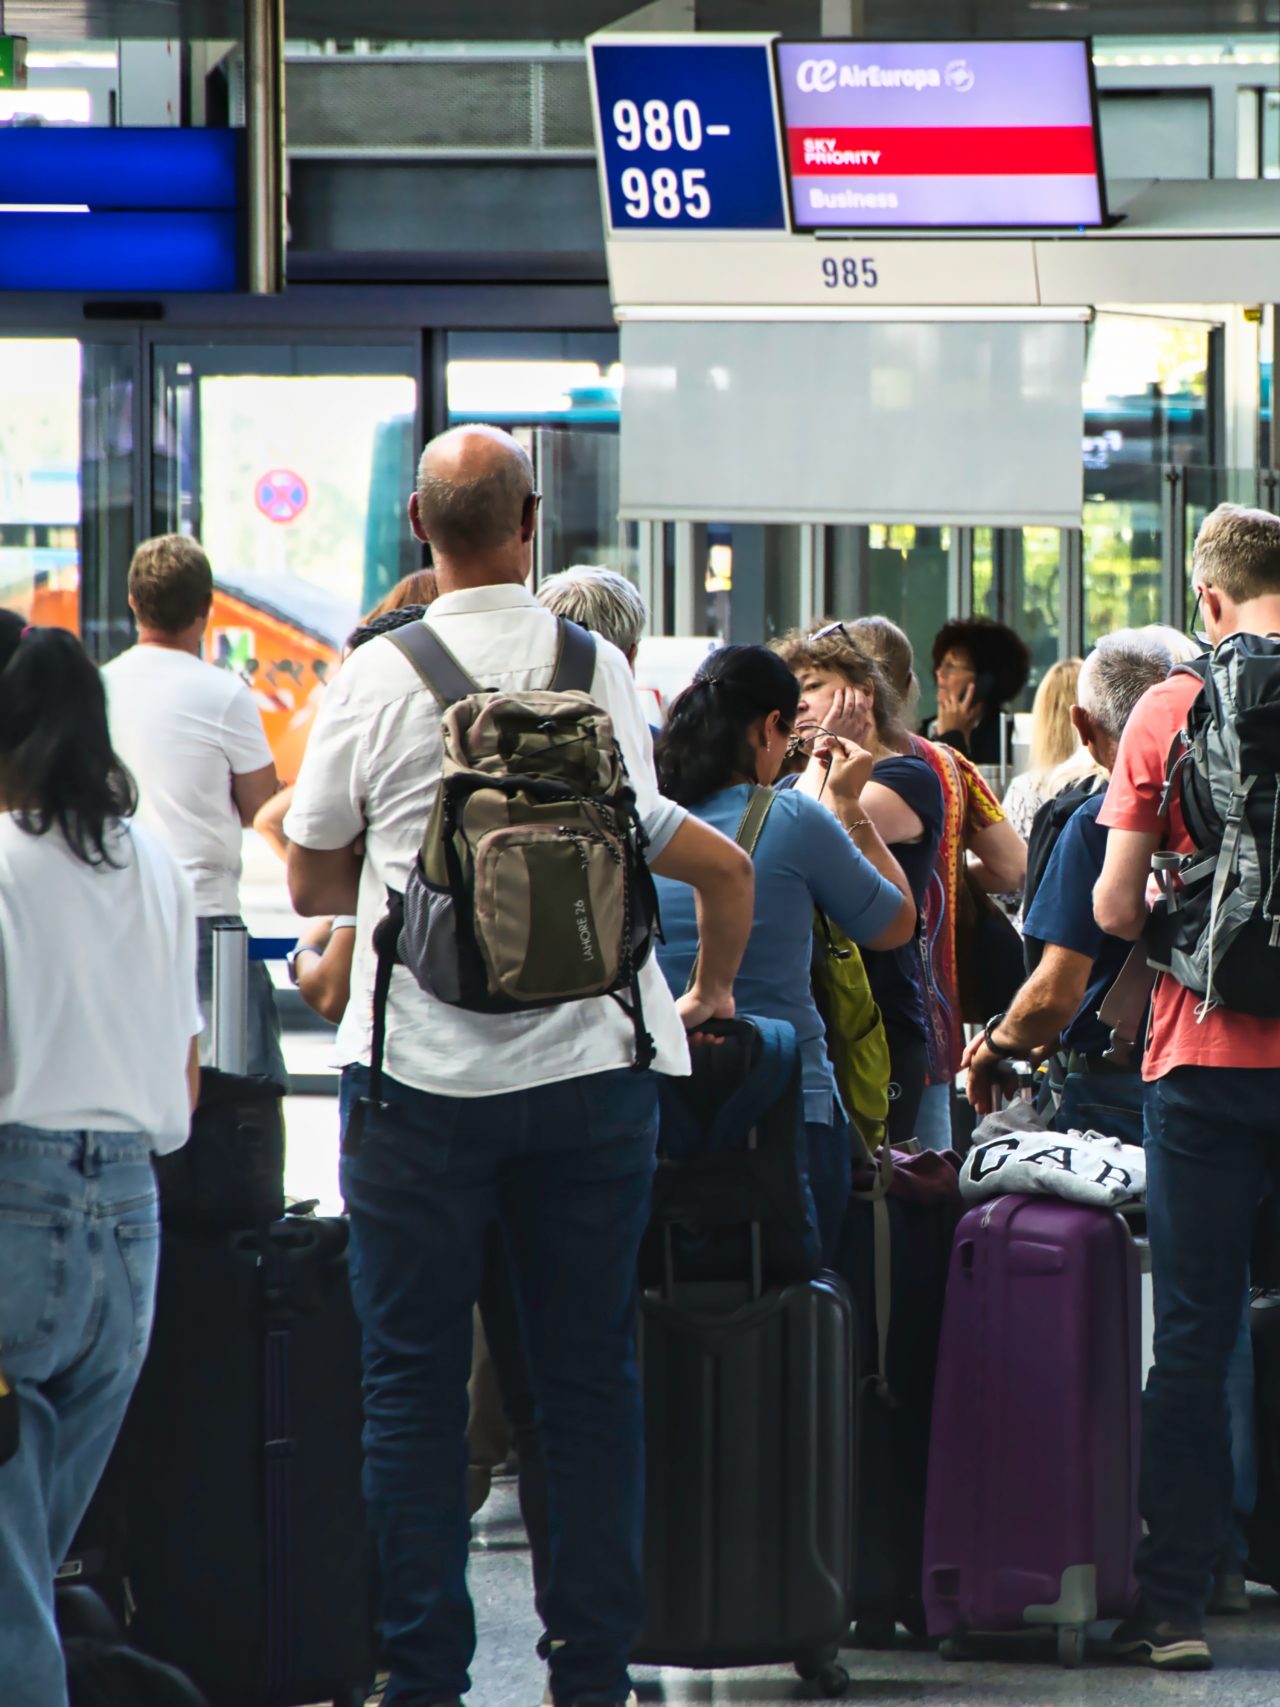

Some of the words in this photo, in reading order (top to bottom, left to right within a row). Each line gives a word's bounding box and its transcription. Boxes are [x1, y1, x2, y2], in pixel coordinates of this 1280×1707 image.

[839, 64, 941, 91] AirEuropa
[612, 99, 731, 151] 980-
[803, 137, 837, 153] SKY
[804, 149, 882, 166] PRIORITY
[620, 168, 712, 219] 985
[809, 188, 899, 209] Business
[821, 257, 879, 289] 985
[573, 899, 586, 915] 26
[576, 916, 594, 962] LAHORE
